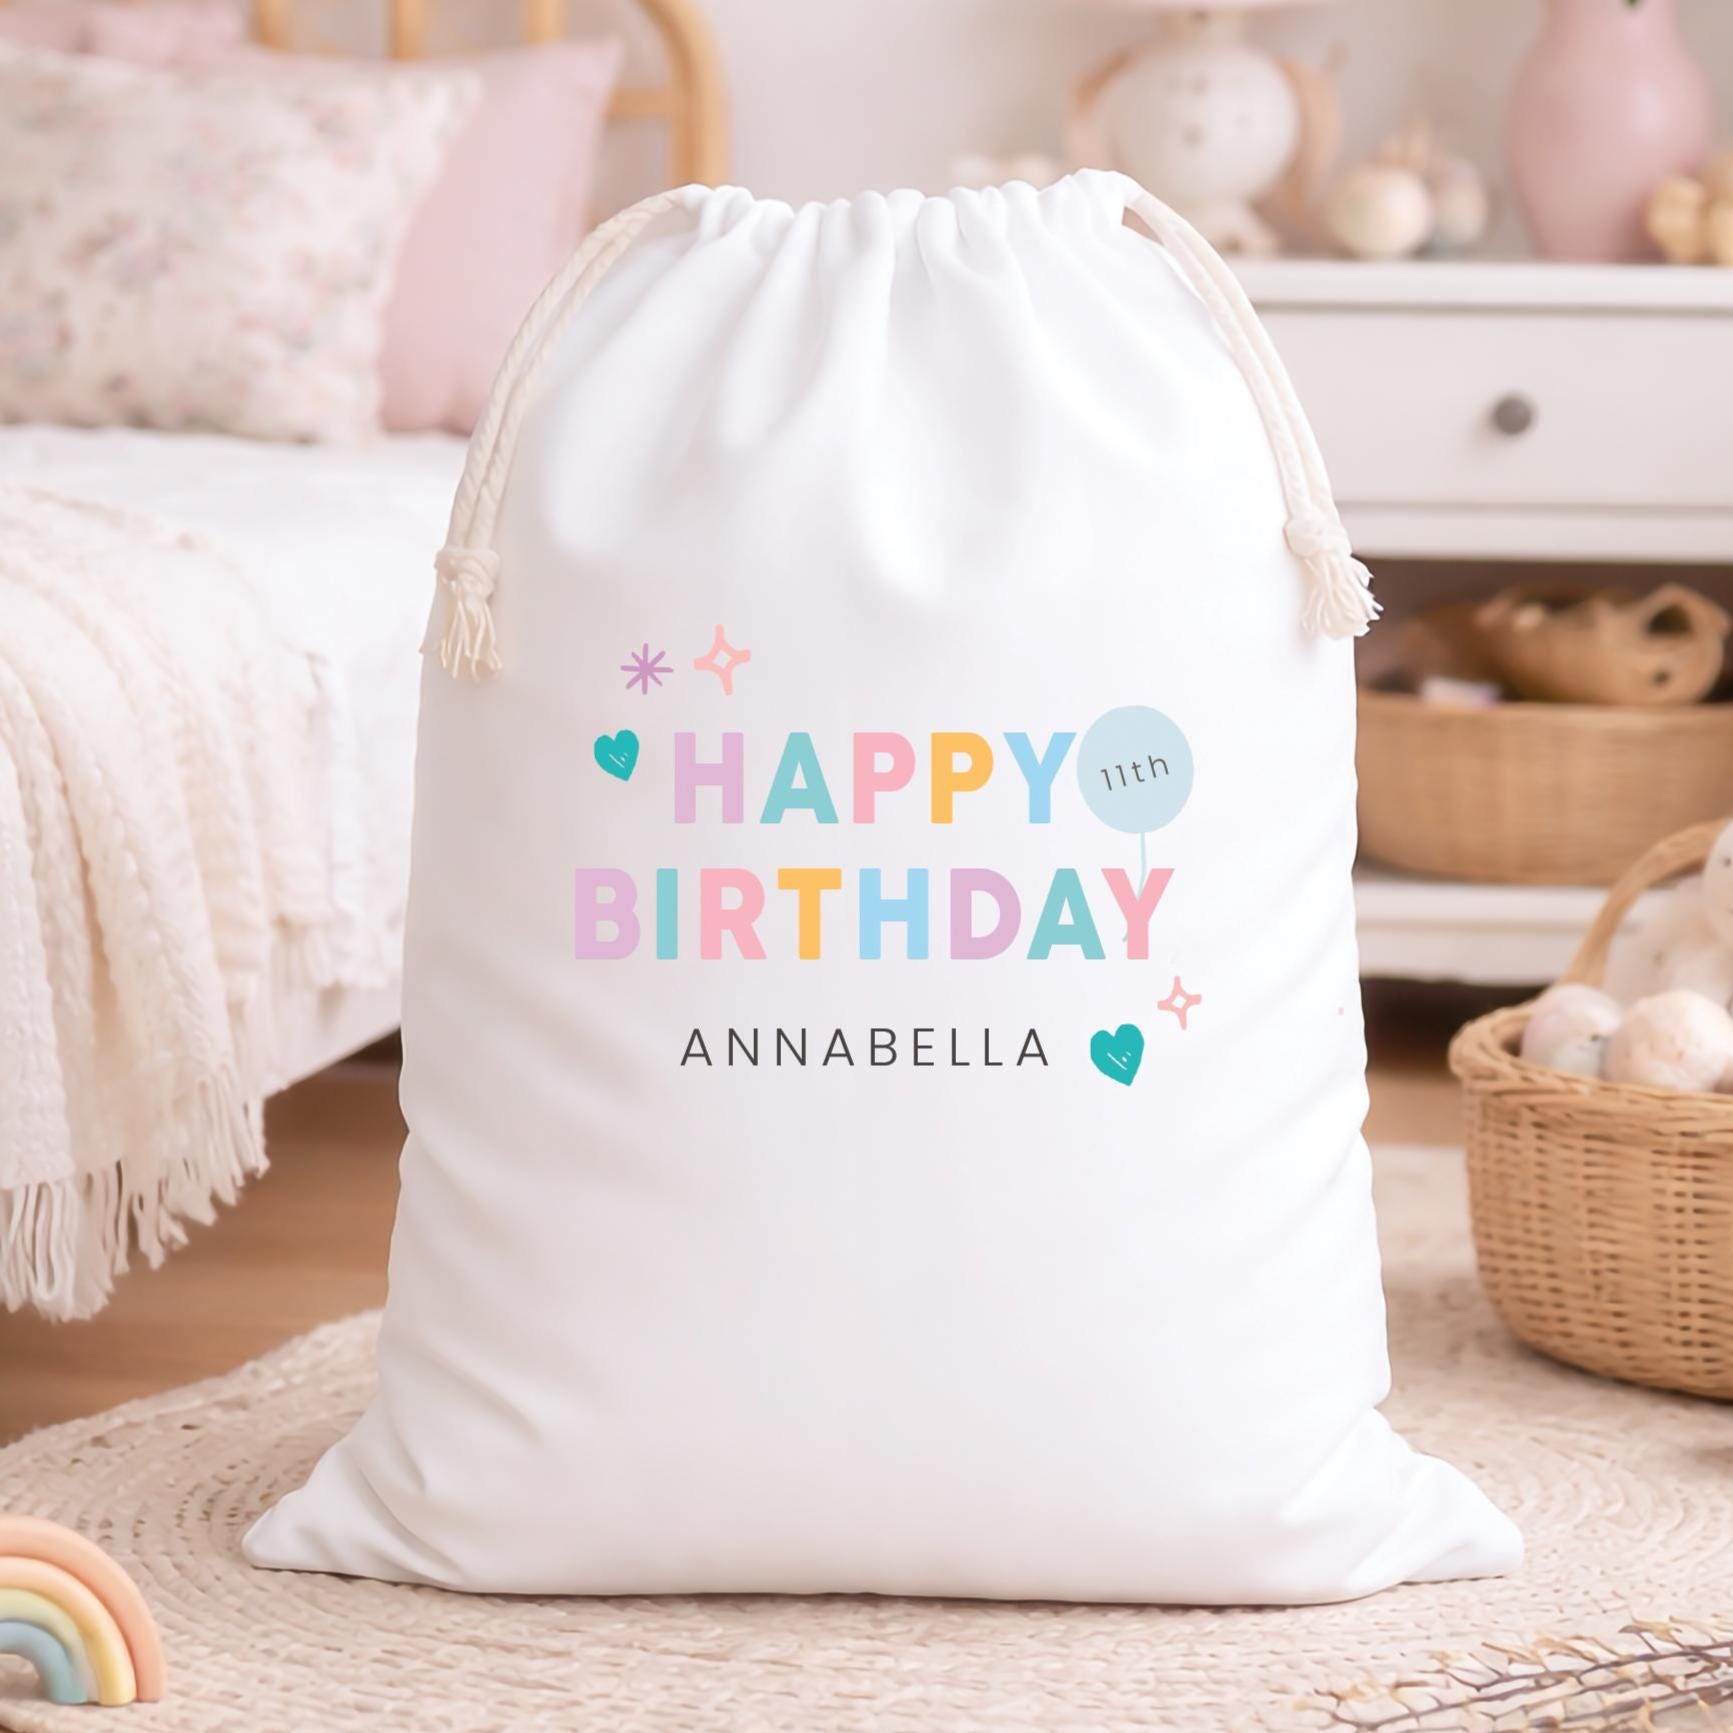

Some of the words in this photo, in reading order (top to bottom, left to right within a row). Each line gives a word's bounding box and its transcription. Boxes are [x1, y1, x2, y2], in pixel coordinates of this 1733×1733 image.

[674, 731, 1078, 825] HAPPY
[1100, 754, 1169, 791] 11th
[574, 867, 1175, 961] BIRTHDAY
[680, 1027, 1050, 1067] ANNABELLA
